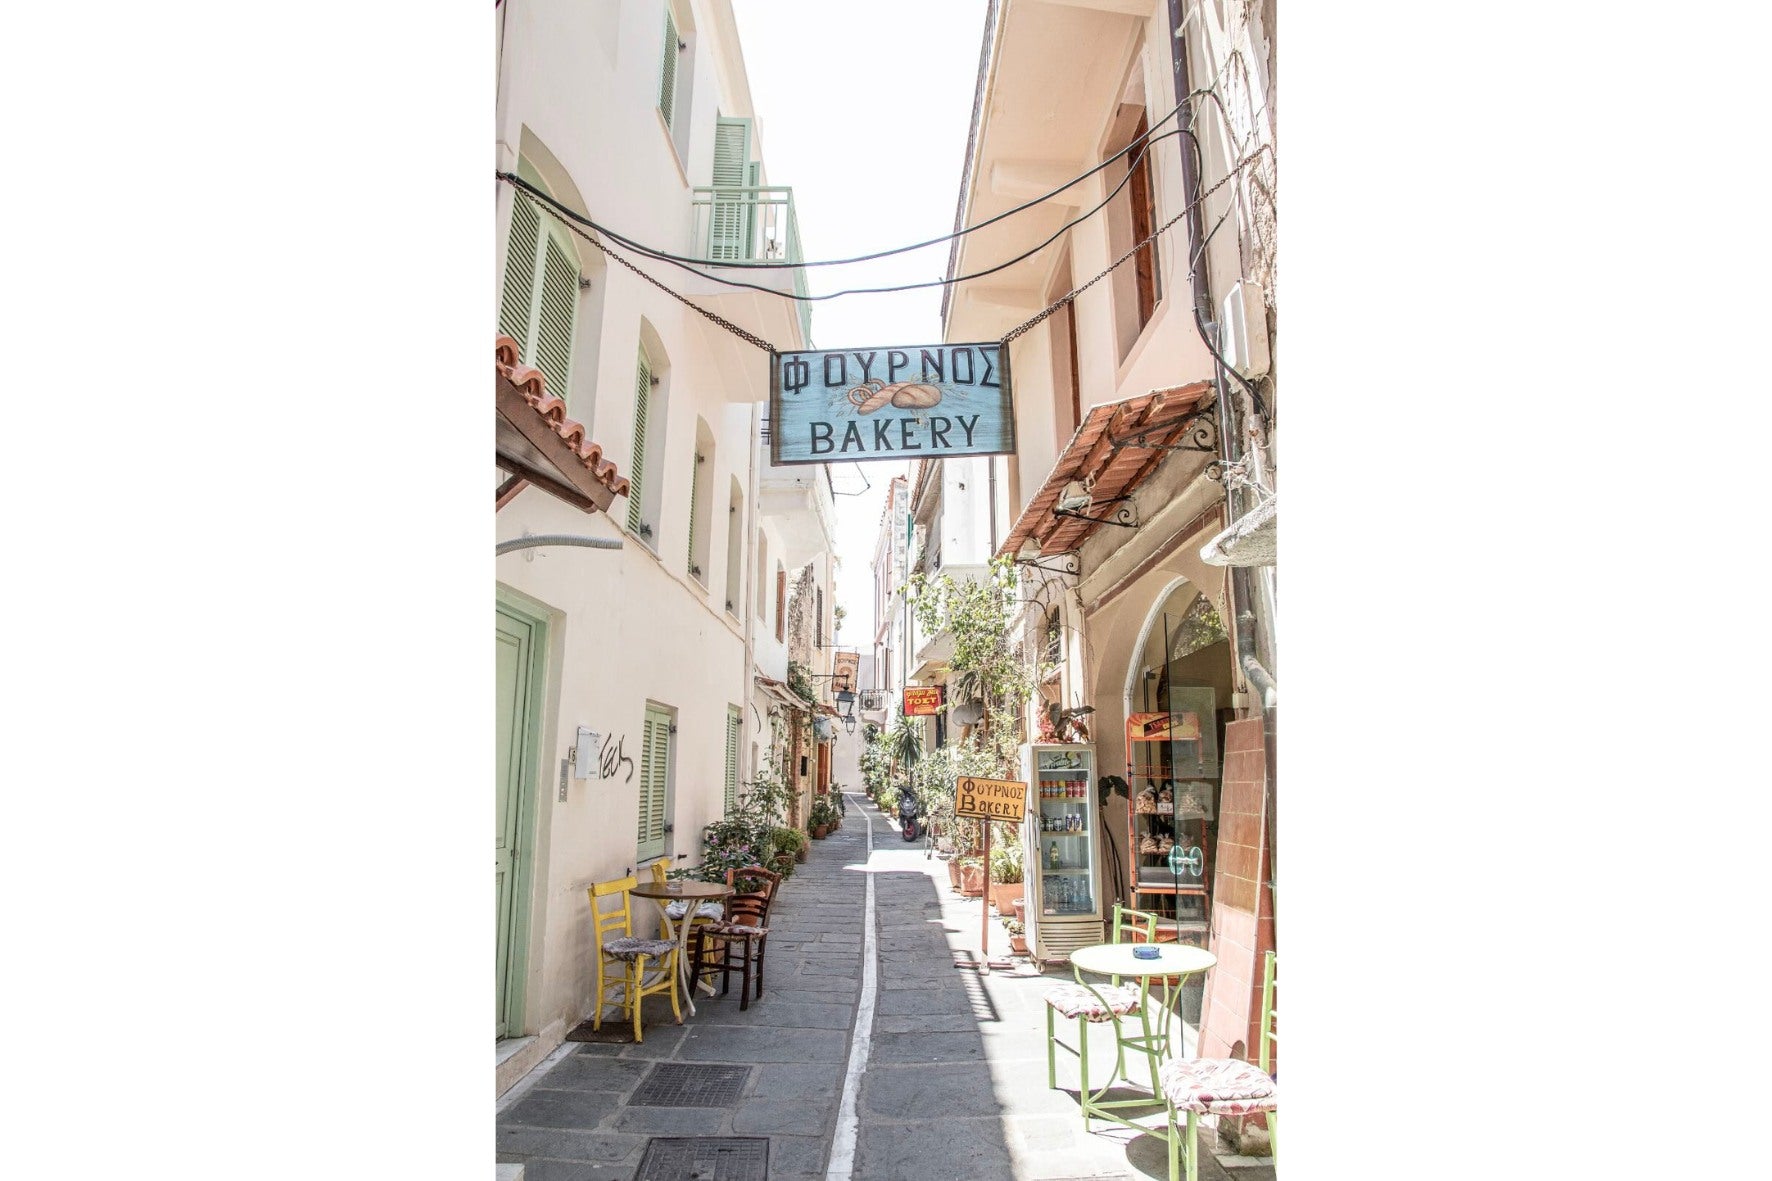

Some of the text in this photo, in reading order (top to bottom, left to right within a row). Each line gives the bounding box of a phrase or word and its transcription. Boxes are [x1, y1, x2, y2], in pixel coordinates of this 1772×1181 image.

[783, 347, 1001, 394] ΦΟΥΡΝΟΣ
[809, 414, 981, 454] BAKERY
[962, 778, 1024, 800] ΦΟΥΡΝΟΣ
